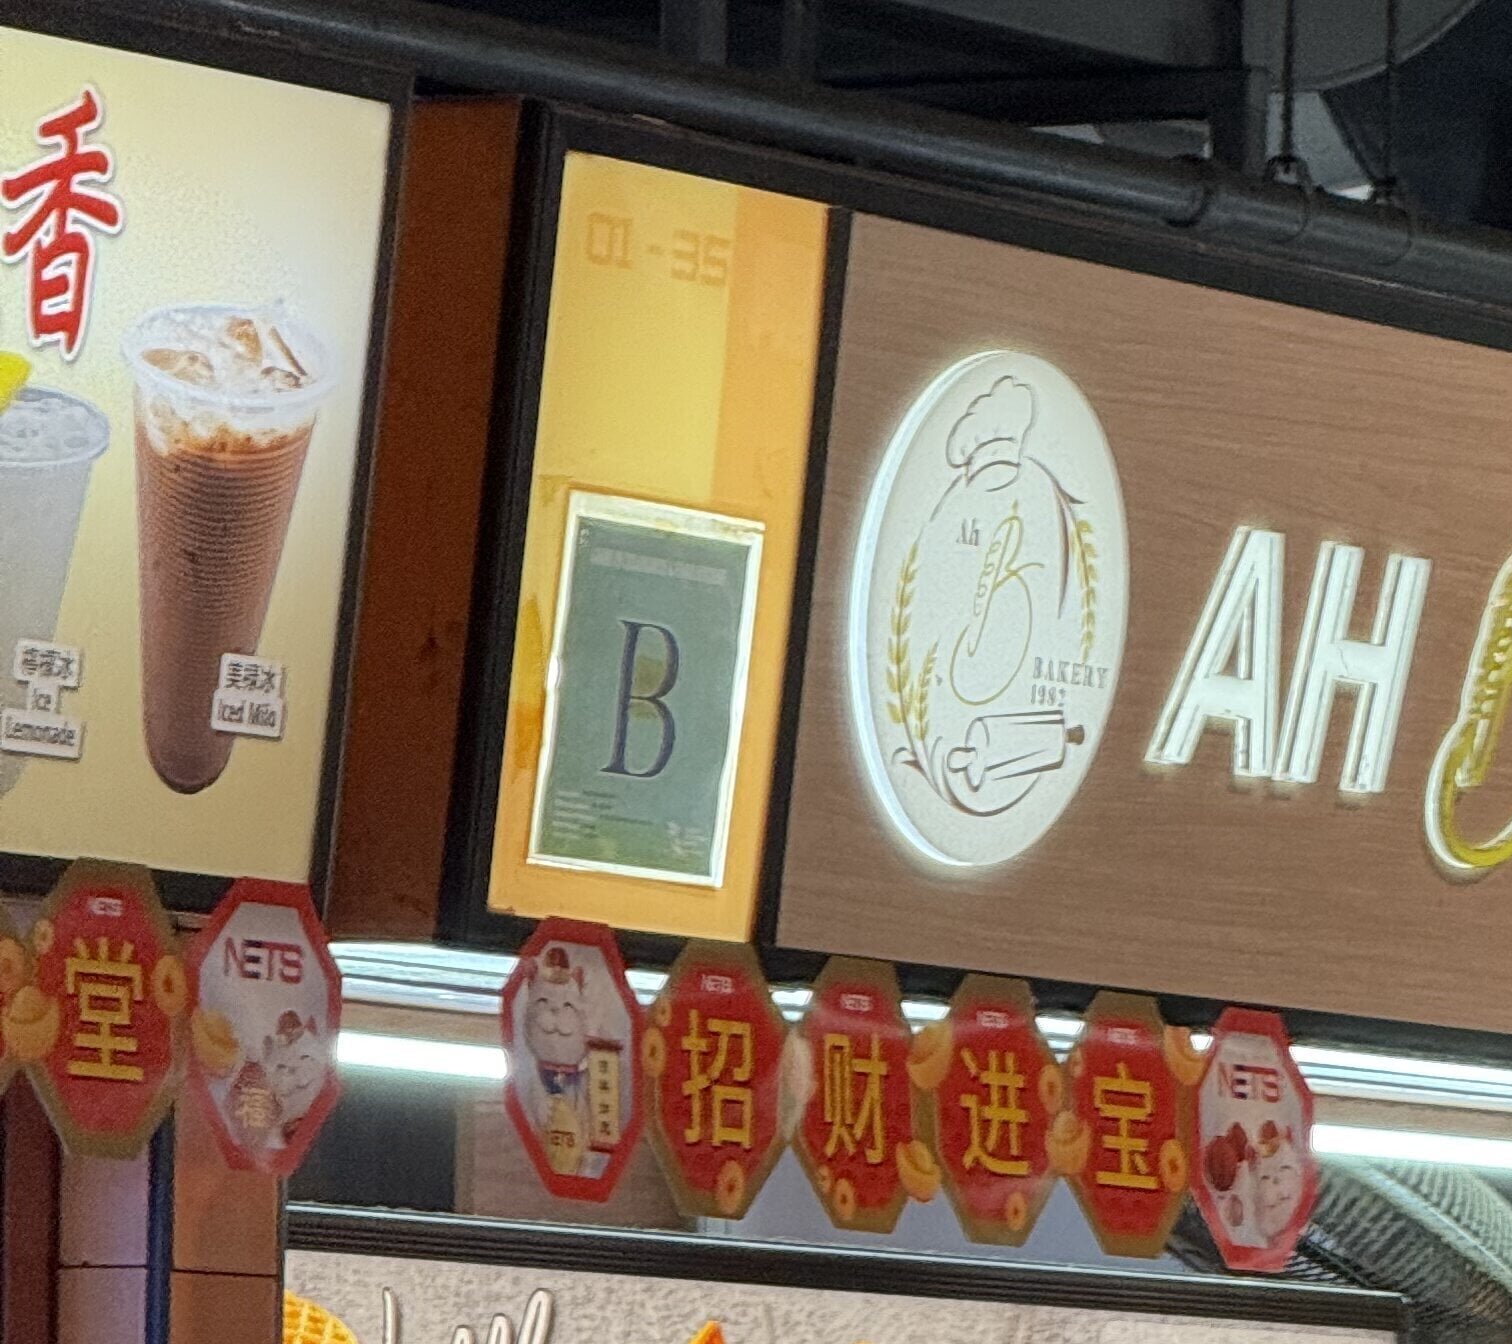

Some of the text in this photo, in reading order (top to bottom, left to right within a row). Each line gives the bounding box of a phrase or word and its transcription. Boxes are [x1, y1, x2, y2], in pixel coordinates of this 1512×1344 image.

[3, 90, 120, 355] 香
[600, 620, 680, 778] B
[1032, 656, 1110, 689] BAKERY
[1144, 525, 1432, 794] AH
[66, 937, 145, 1082] 堂
[223, 937, 304, 984] NETS
